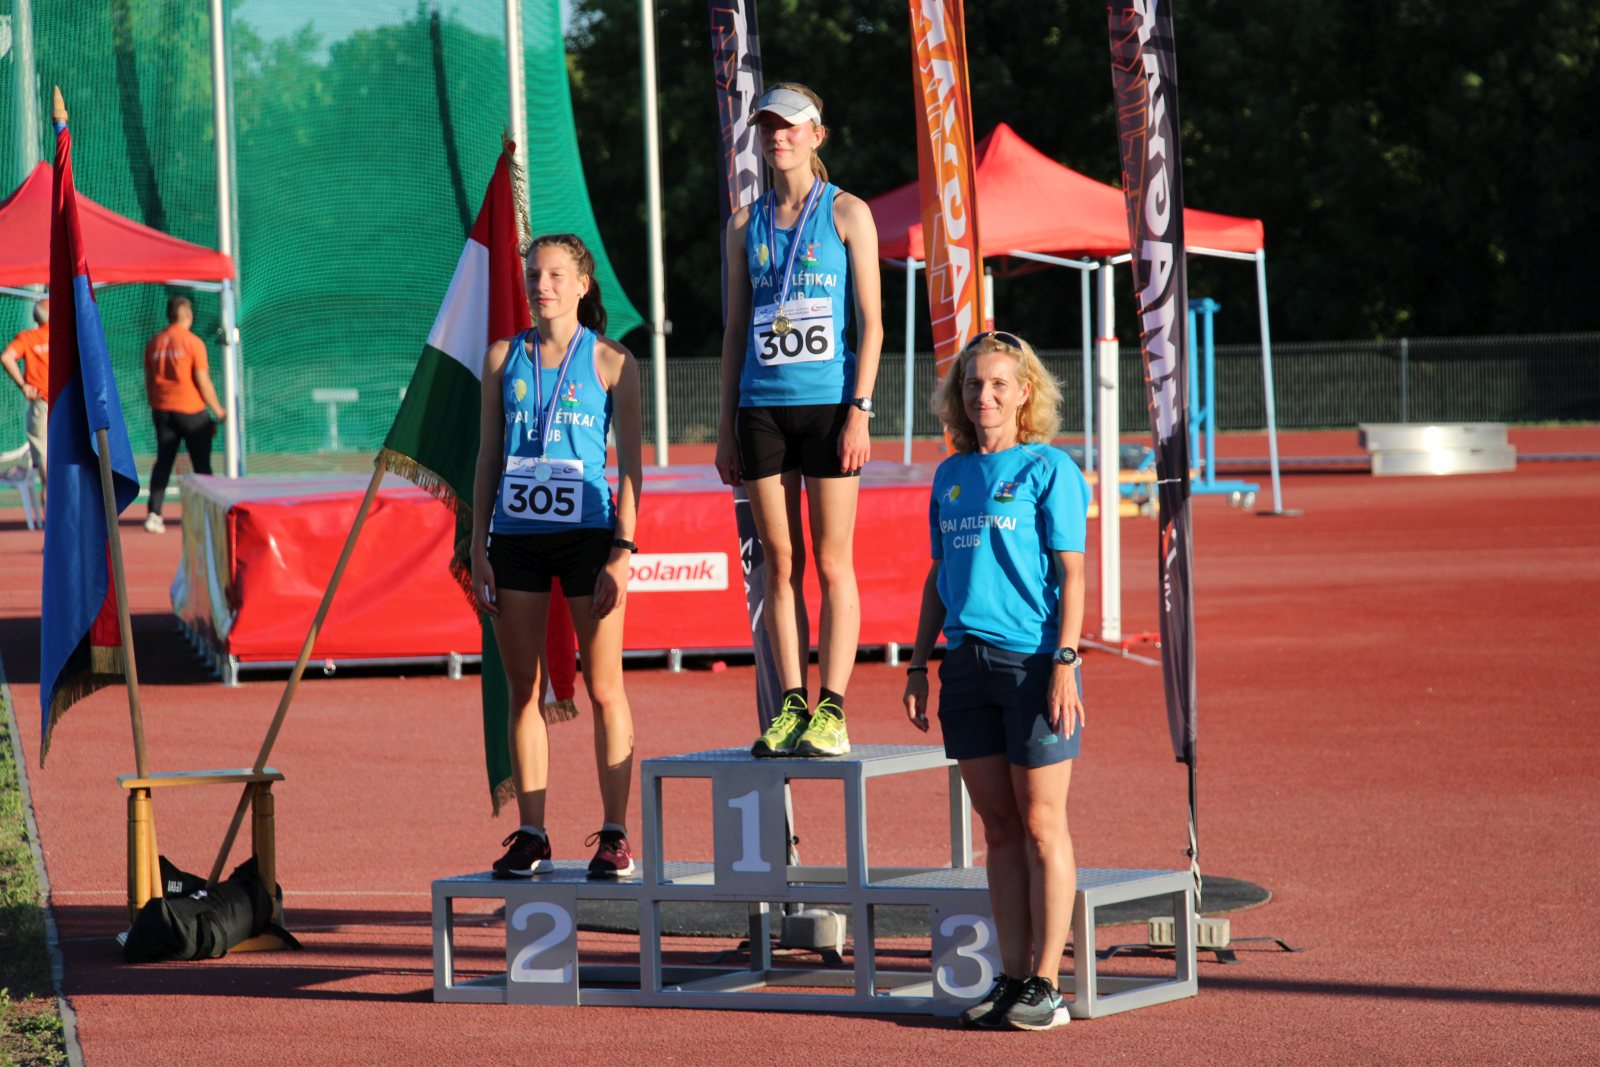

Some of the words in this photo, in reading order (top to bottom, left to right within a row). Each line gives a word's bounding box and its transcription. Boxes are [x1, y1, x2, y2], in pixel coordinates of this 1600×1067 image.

[759, 325, 829, 360] 306
[527, 428, 562, 442] CUB
[508, 483, 575, 516] 305
[959, 511, 1018, 531] ATLÉTIKAI
[953, 534, 980, 549] CLUB
[727, 789, 772, 873] 1
[510, 901, 573, 984] 2
[936, 913, 1001, 998] 3
